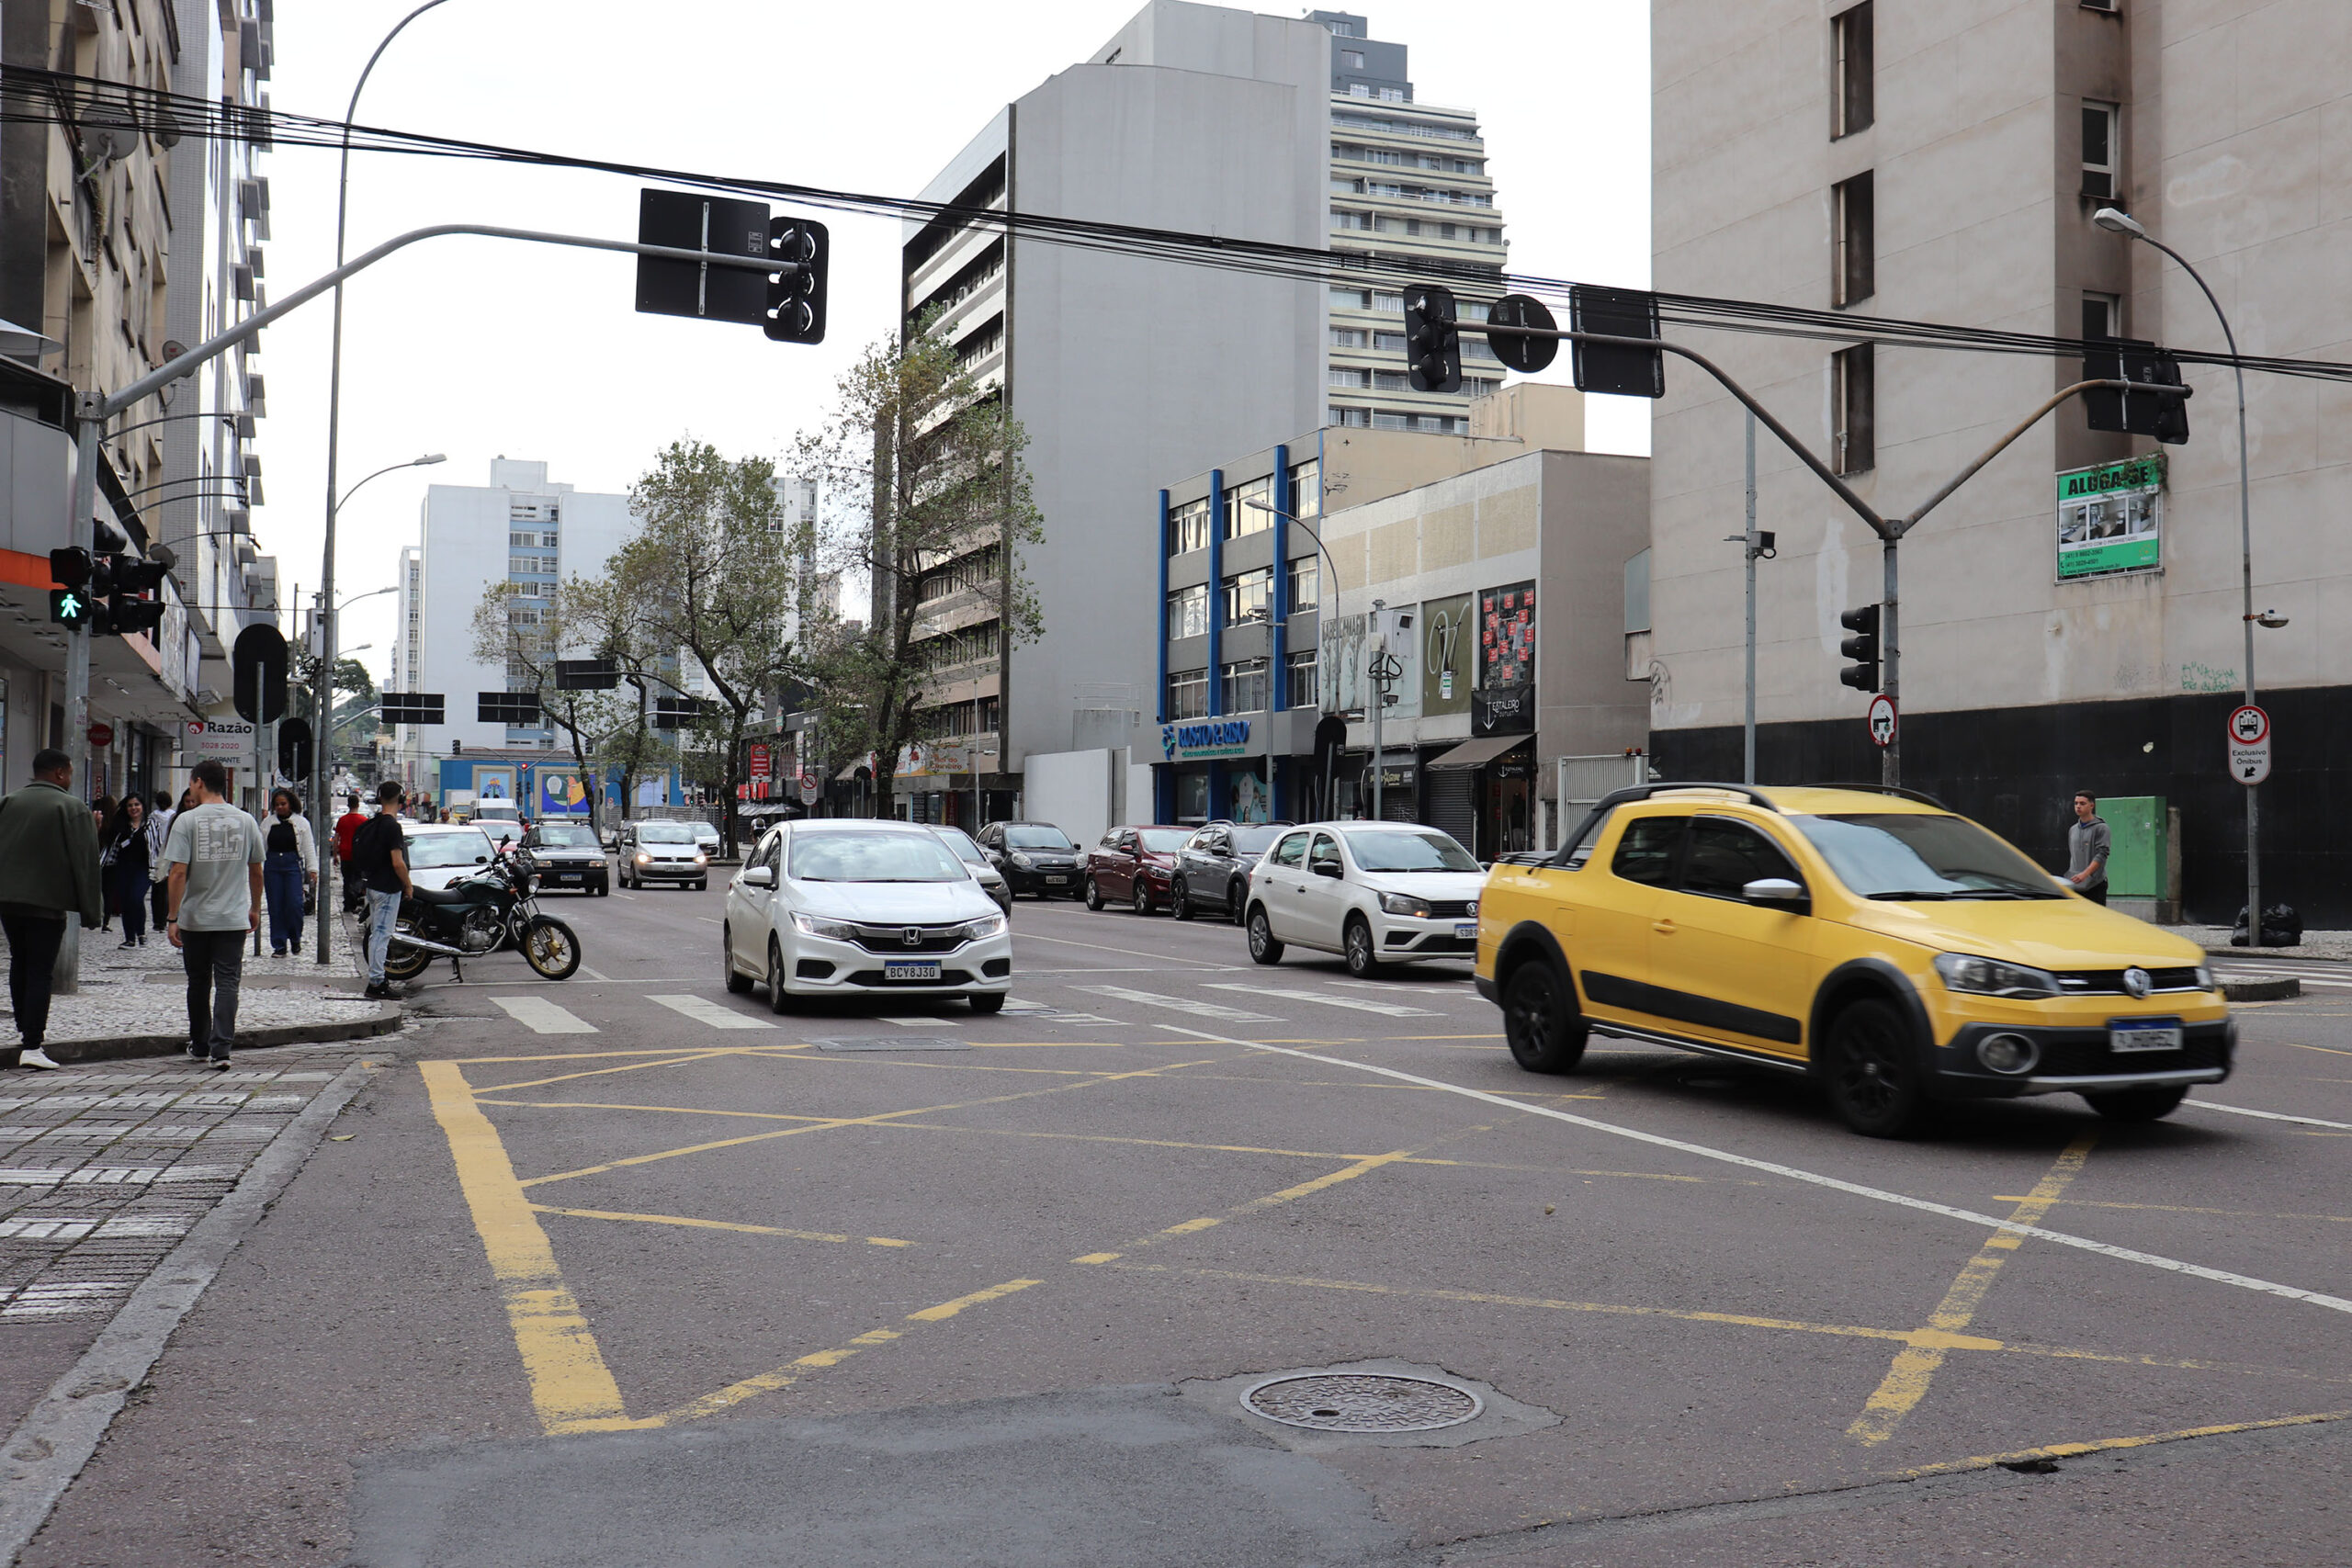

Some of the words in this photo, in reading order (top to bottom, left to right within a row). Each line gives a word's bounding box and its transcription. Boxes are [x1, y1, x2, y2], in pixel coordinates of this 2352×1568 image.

[2068, 466, 2149, 496] ALUGA-SE
[1492, 699, 1520, 713] ESTALEIRO
[207, 721, 252, 734] Razão
[1179, 725, 1212, 748] ROSTO
[890, 967, 935, 977] BCY8J30
